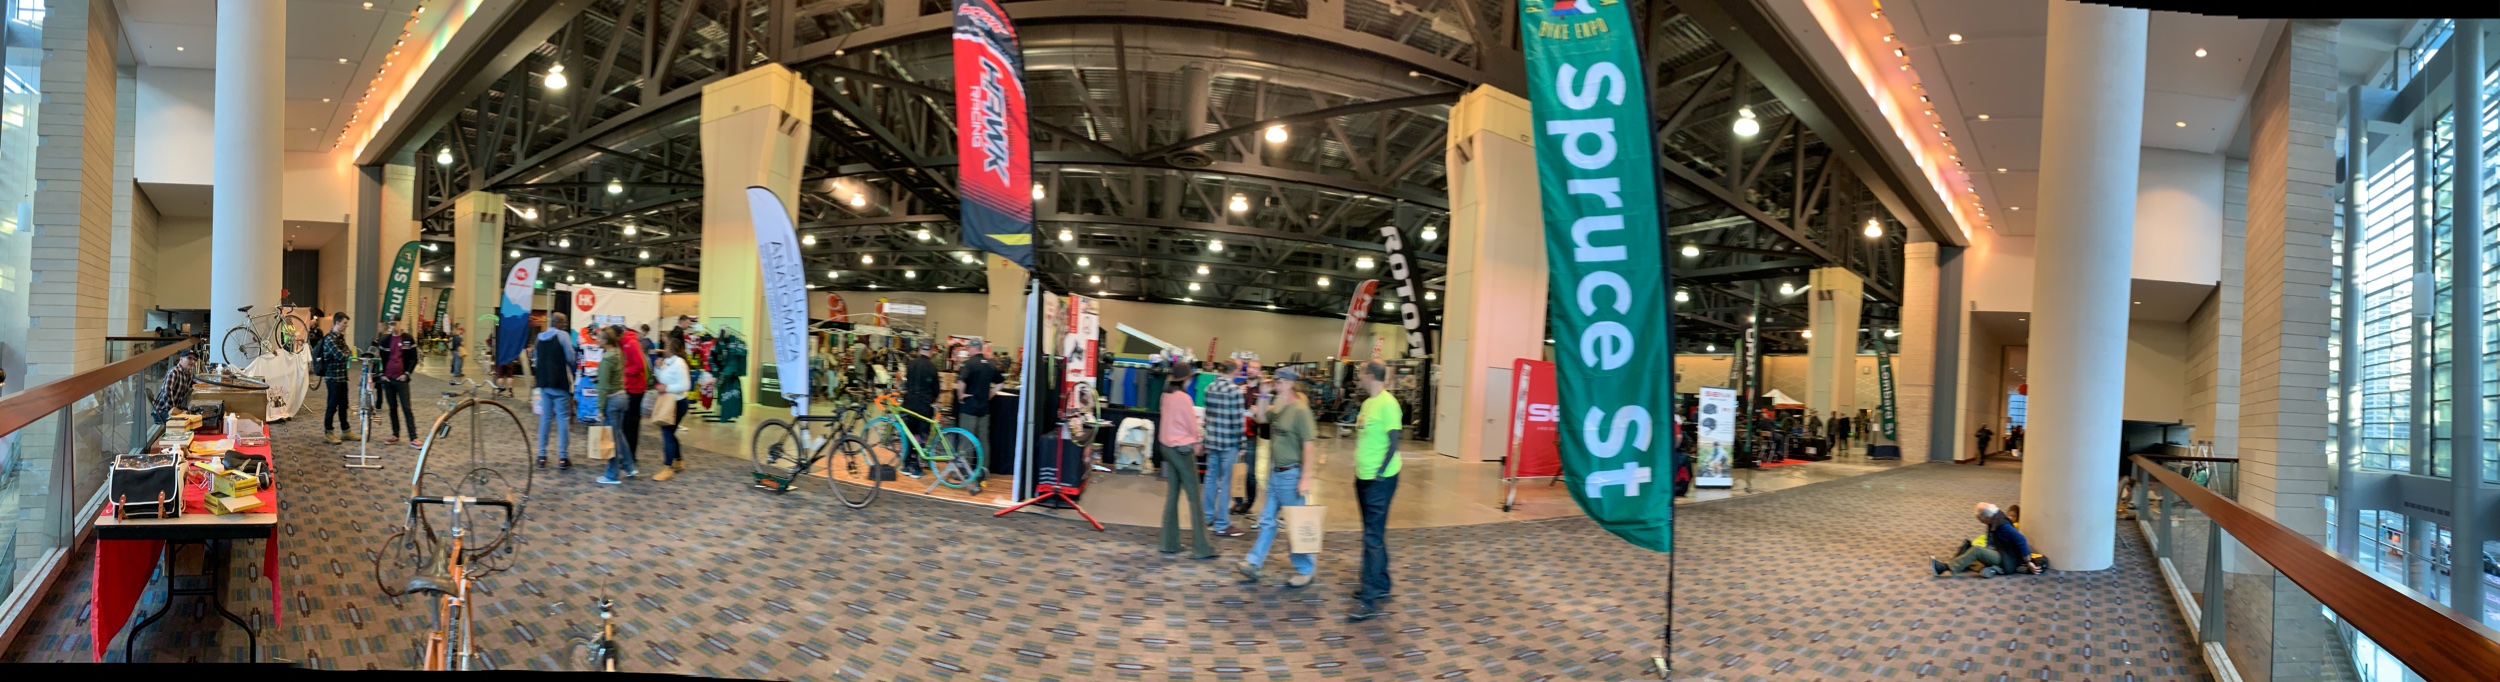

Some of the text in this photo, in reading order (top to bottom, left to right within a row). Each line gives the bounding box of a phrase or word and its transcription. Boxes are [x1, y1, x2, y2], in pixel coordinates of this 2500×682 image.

[1538, 18, 1608, 39] BIKE EXPO
[969, 86, 983, 148] RACING
[979, 55, 1010, 188] HAWK
[393, 266, 410, 283] St
[579, 294, 594, 306] HK
[769, 241, 800, 362] ANATOMICA
[1380, 226, 1427, 357] ROTOR
[1546, 61, 1653, 499] Spruce St
[1880, 364, 1893, 419] Lombard
